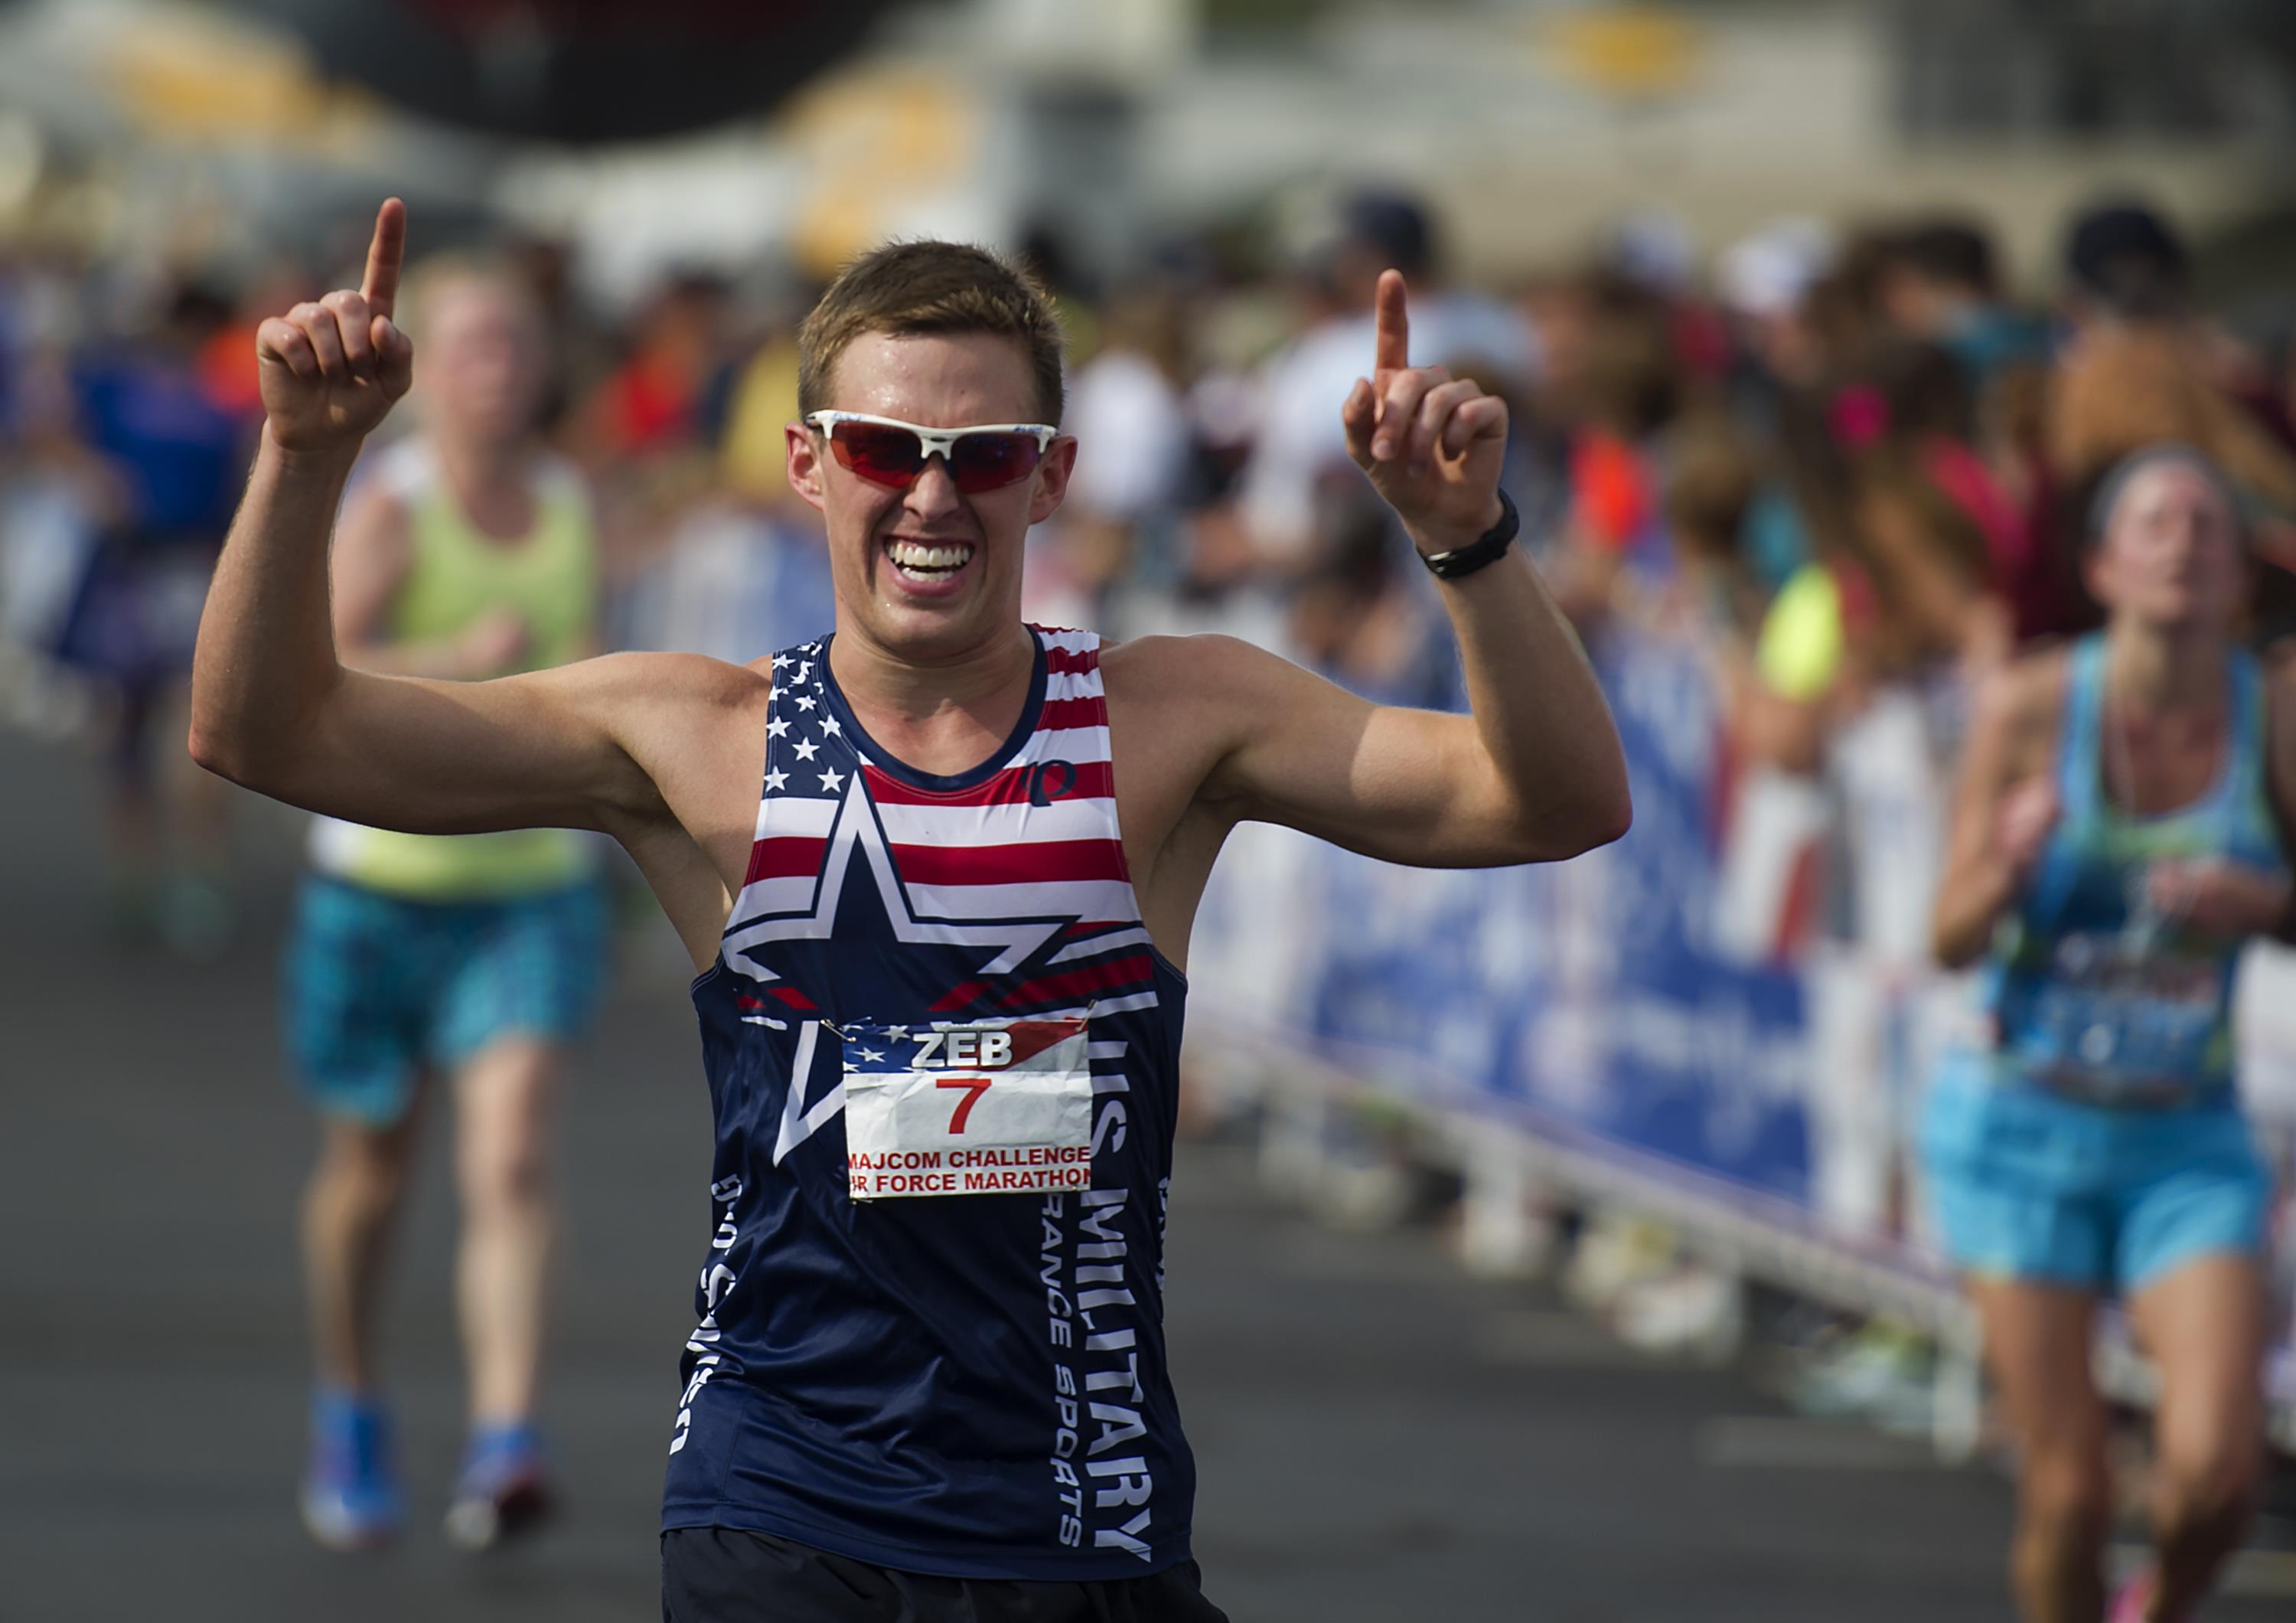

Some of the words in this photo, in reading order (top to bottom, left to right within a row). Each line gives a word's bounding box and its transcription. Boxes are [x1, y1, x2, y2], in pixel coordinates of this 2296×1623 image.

[911, 1030, 1013, 1068] ZEB
[935, 1078, 992, 1134] 7
[948, 1146, 1091, 1168] CHALLENGE
[876, 1173, 957, 1192] FORCE
[1075, 1188, 1153, 1563] MILITARY
[1049, 1363, 1083, 1548] SPORTS
